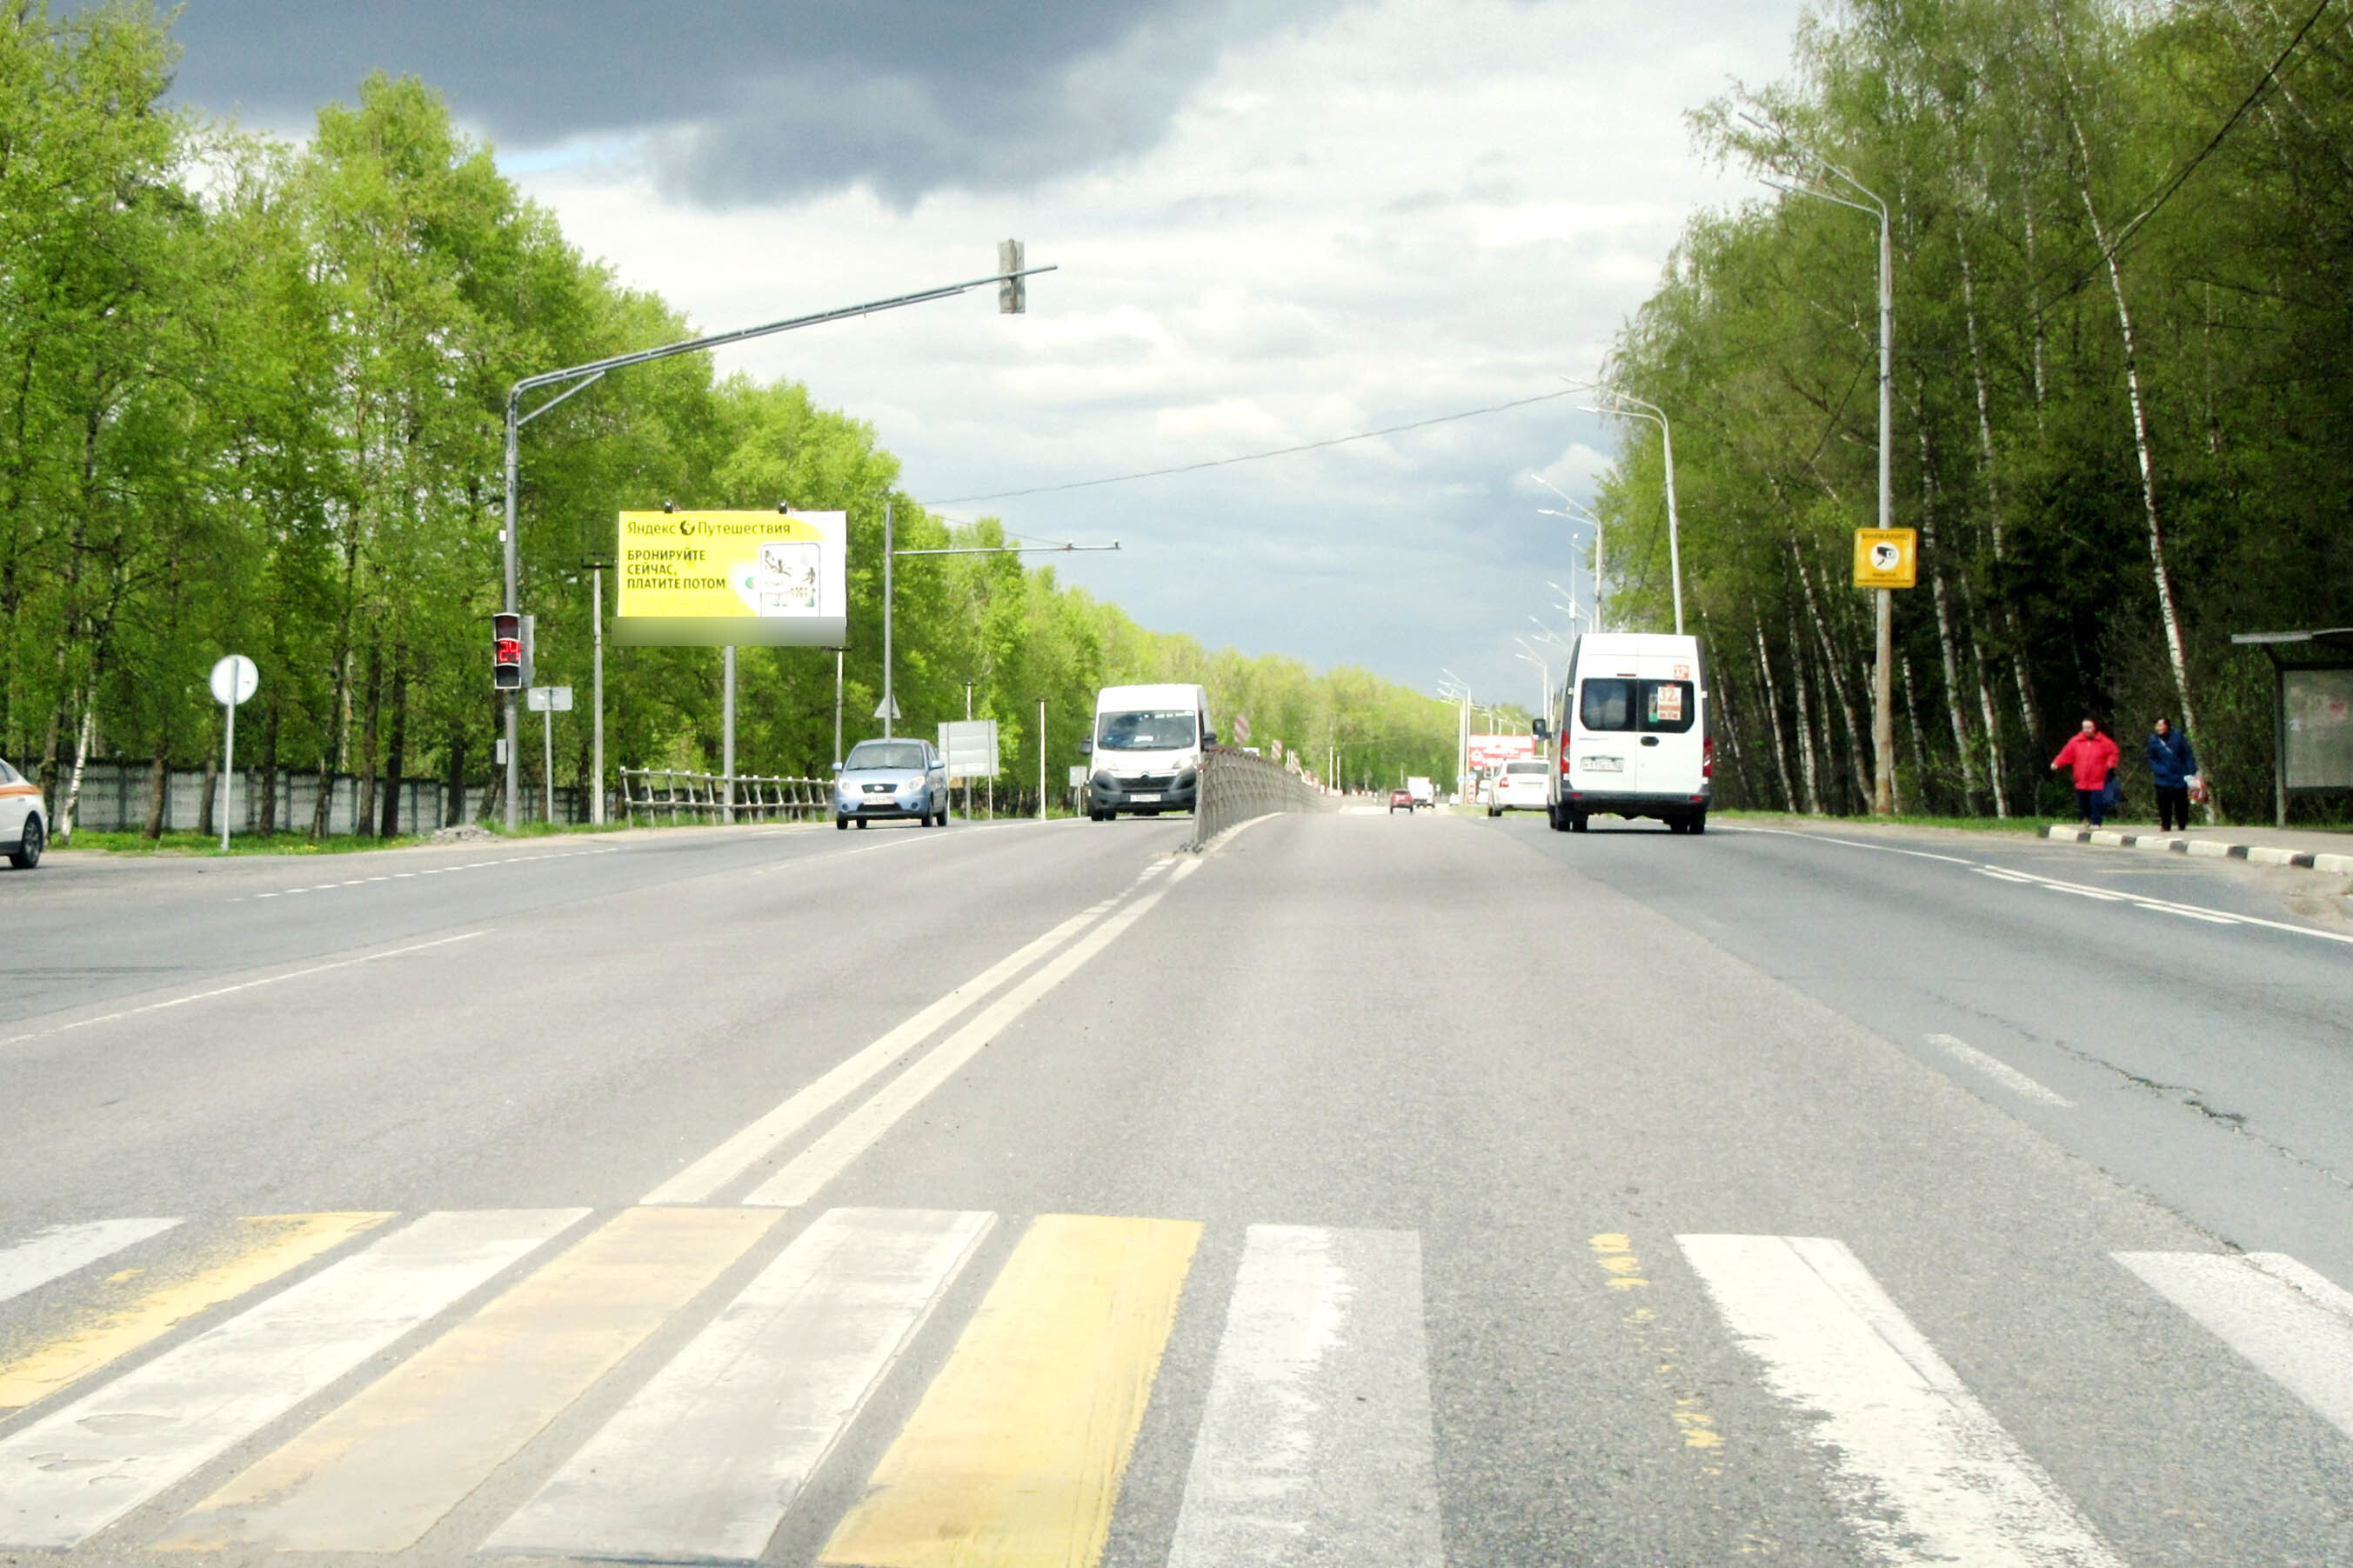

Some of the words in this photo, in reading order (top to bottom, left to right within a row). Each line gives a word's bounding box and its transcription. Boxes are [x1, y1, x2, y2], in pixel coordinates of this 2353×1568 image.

[627, 522, 676, 536] Яндекс
[698, 521, 791, 536] Путешествия
[627, 548, 705, 561] БРОНИРУЙТЕ
[627, 563, 677, 576] СЕЙЧАС,
[627, 578, 681, 590] ПЛАТИТЕ
[684, 577, 725, 590] ПОТОМ
[498, 640, 520, 663] 24
